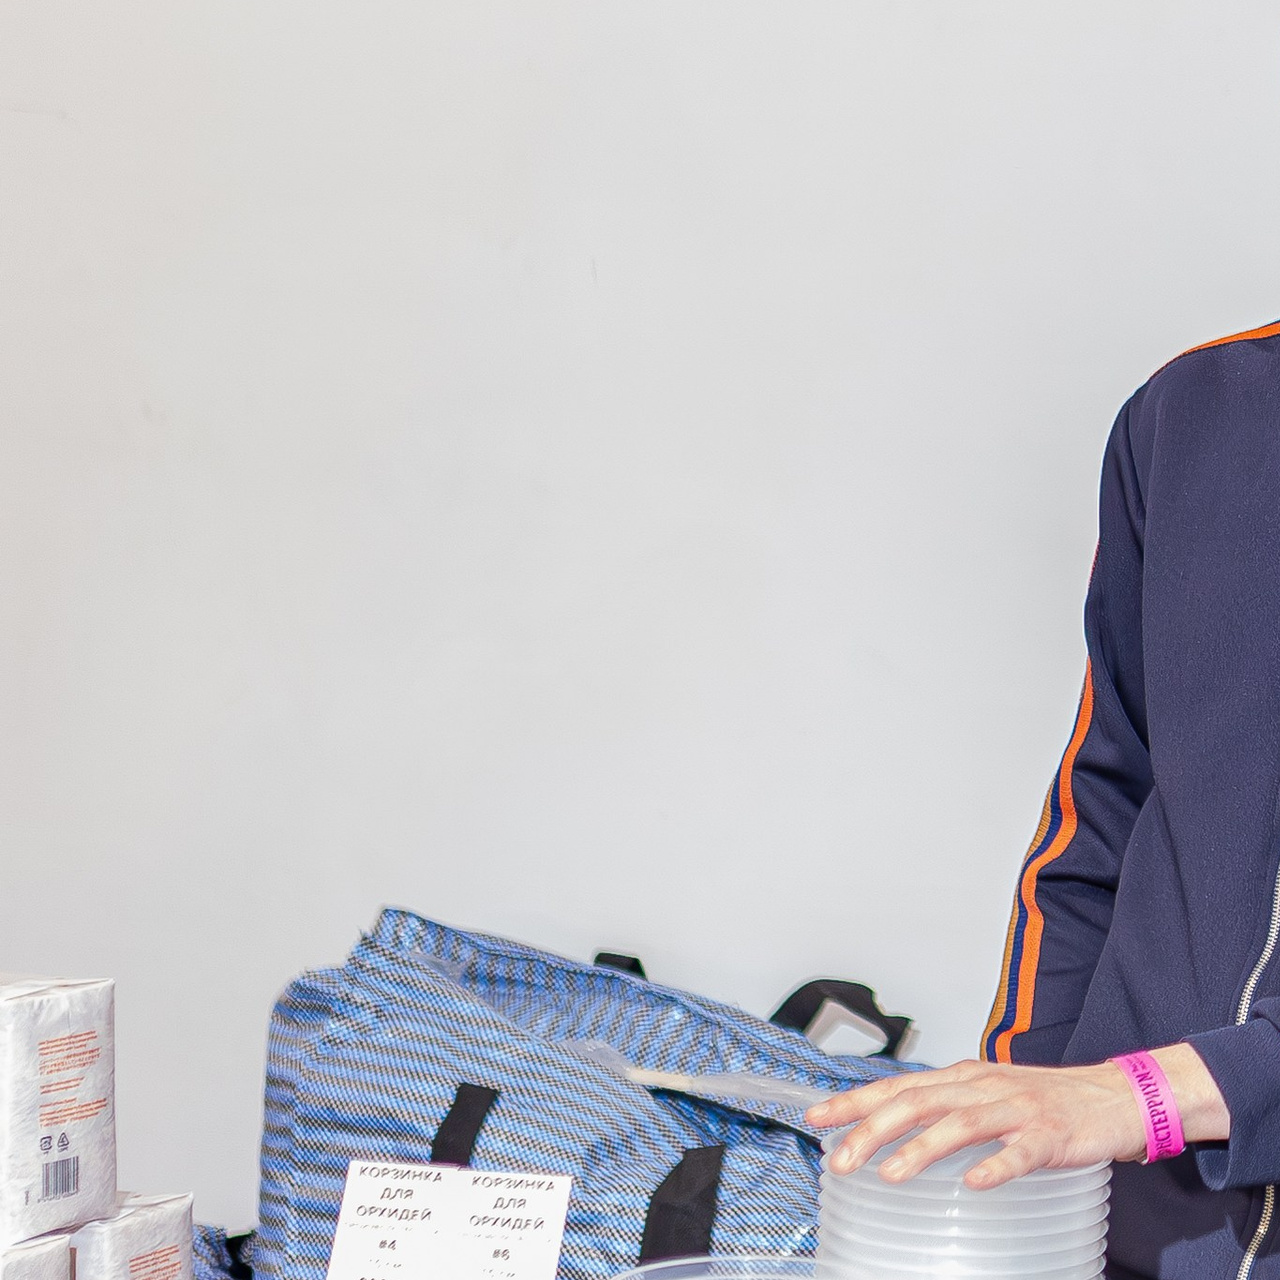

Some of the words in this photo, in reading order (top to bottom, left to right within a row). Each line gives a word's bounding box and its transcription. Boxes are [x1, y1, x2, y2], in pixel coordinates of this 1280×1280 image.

[358, 1165, 443, 1183] КОРЗИНКА
[471, 1175, 556, 1192] КОРЗИНКА
[379, 1186, 414, 1200] ДЛЯ
[492, 1196, 527, 1210] ДЛЯ
[355, 1204, 432, 1222] ОРХИДЕЙ
[468, 1214, 546, 1231] ОРХИДЕЙ
